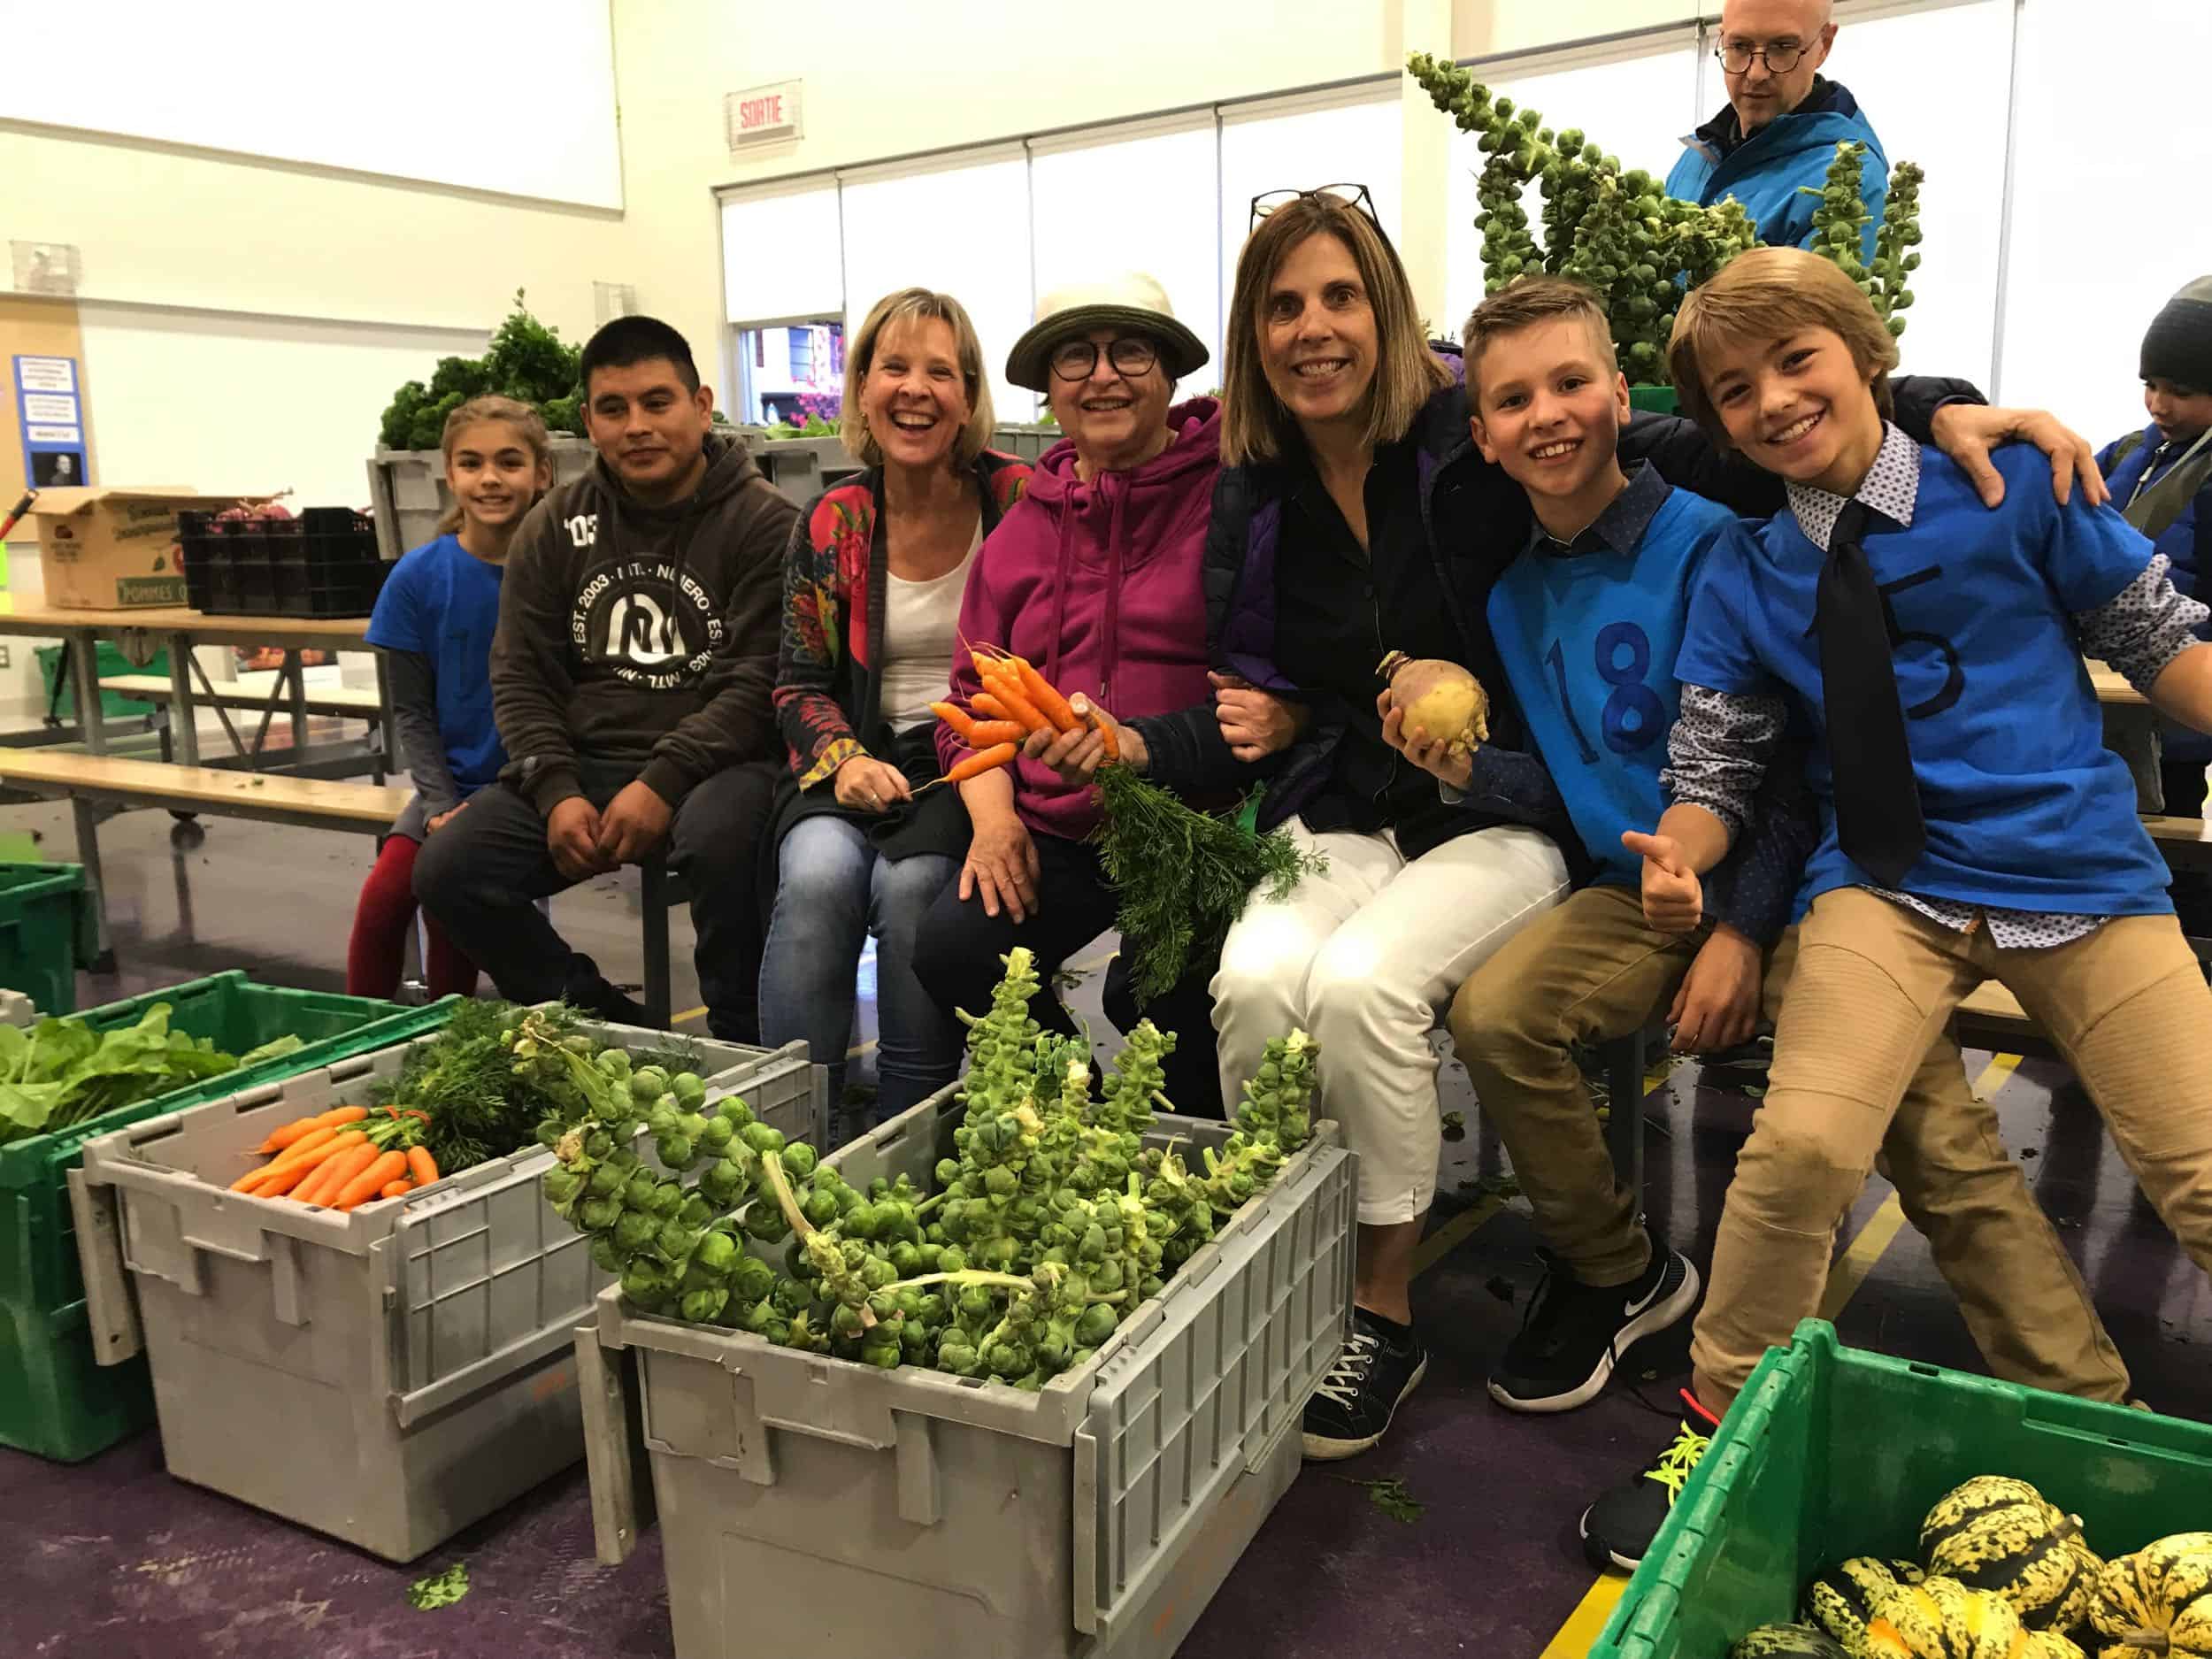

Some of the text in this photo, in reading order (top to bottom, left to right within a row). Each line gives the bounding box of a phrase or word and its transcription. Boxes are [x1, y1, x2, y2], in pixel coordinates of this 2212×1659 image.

[740, 94, 782, 128] SORTIE
[578, 573, 610, 610] 2003
[572, 610, 588, 644] EST.
[1544, 621, 1666, 765] 18
